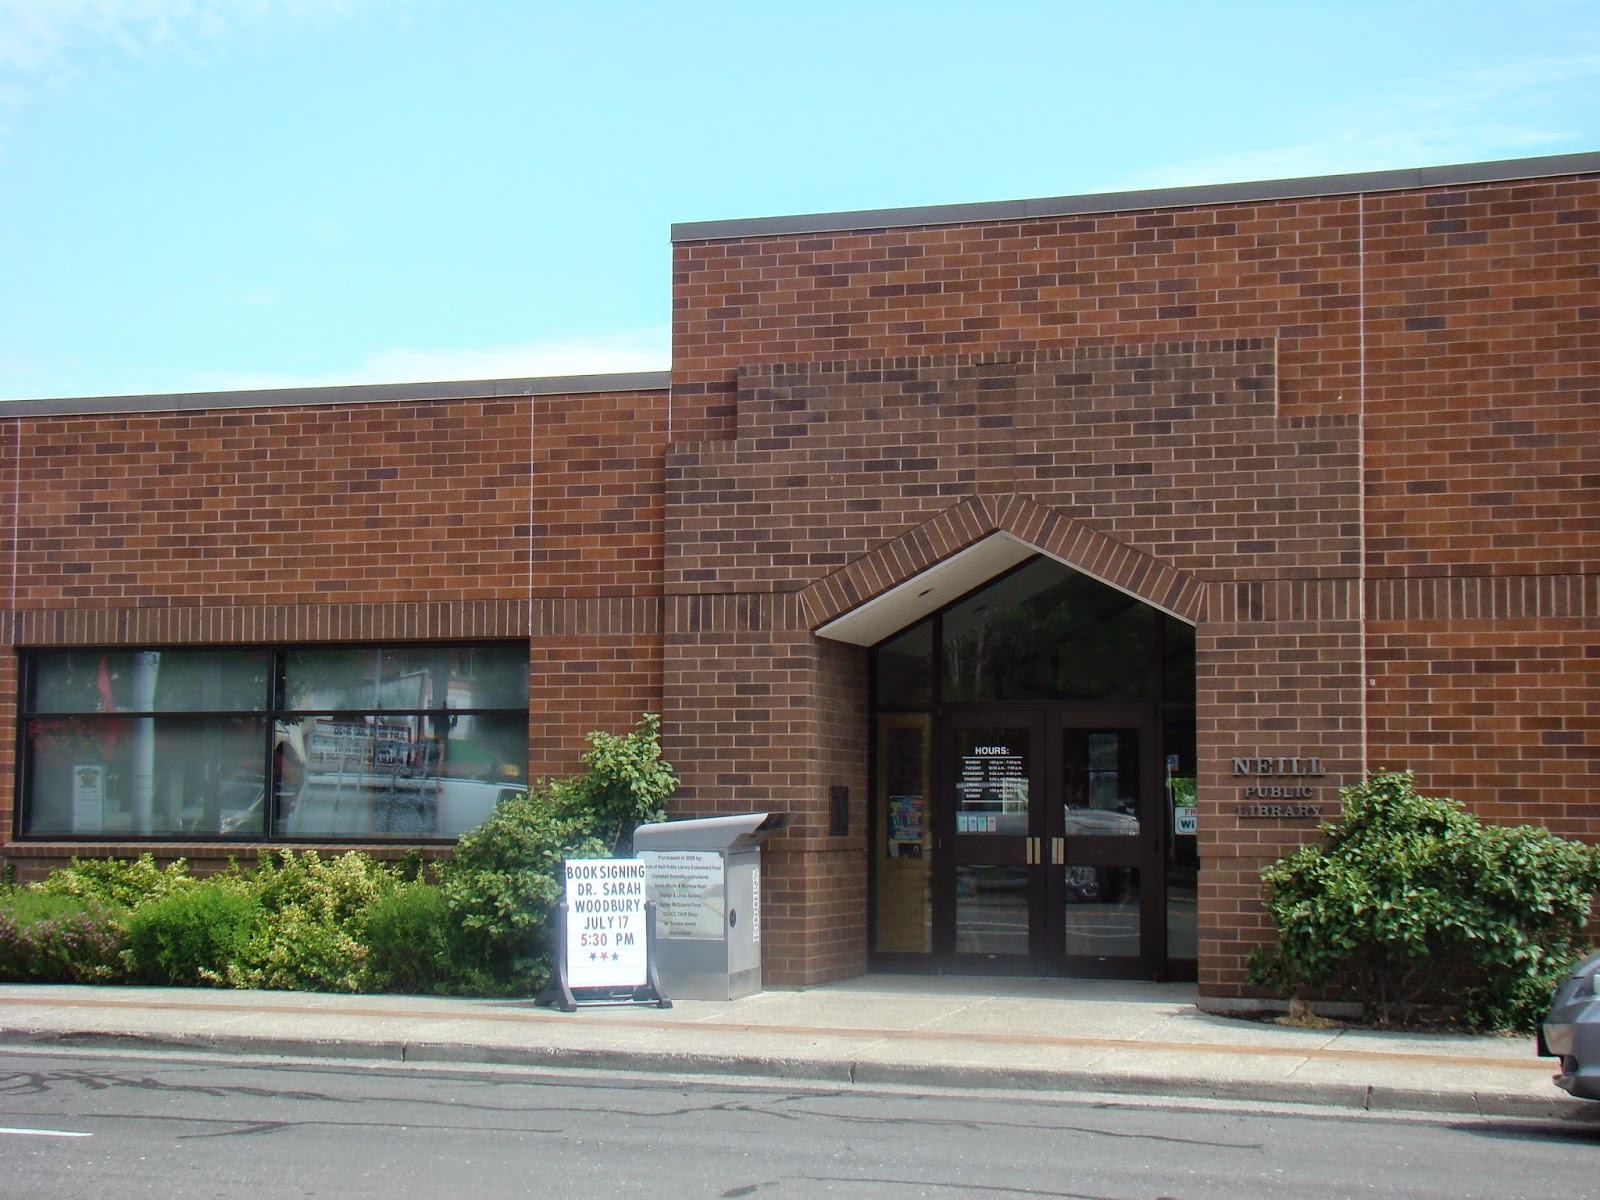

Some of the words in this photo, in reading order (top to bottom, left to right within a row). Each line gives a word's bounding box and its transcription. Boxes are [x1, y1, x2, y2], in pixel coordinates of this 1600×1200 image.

[975, 746, 1010, 755] HOURS:
[1232, 756, 1326, 776] NEILL
[1245, 786, 1314, 798] PUBLIC
[1237, 805, 1322, 818] LIBRARY
[567, 866, 598, 879] BOOK
[600, 865, 645, 879] SIGNING
[578, 883, 597, 896] DR.
[603, 882, 641, 896] SARAH
[575, 899, 640, 913] WOODBURY
[584, 916, 614, 929] JULY
[618, 916, 629, 929] 17
[581, 933, 608, 946] 5:30
[616, 932, 634, 946] PM
